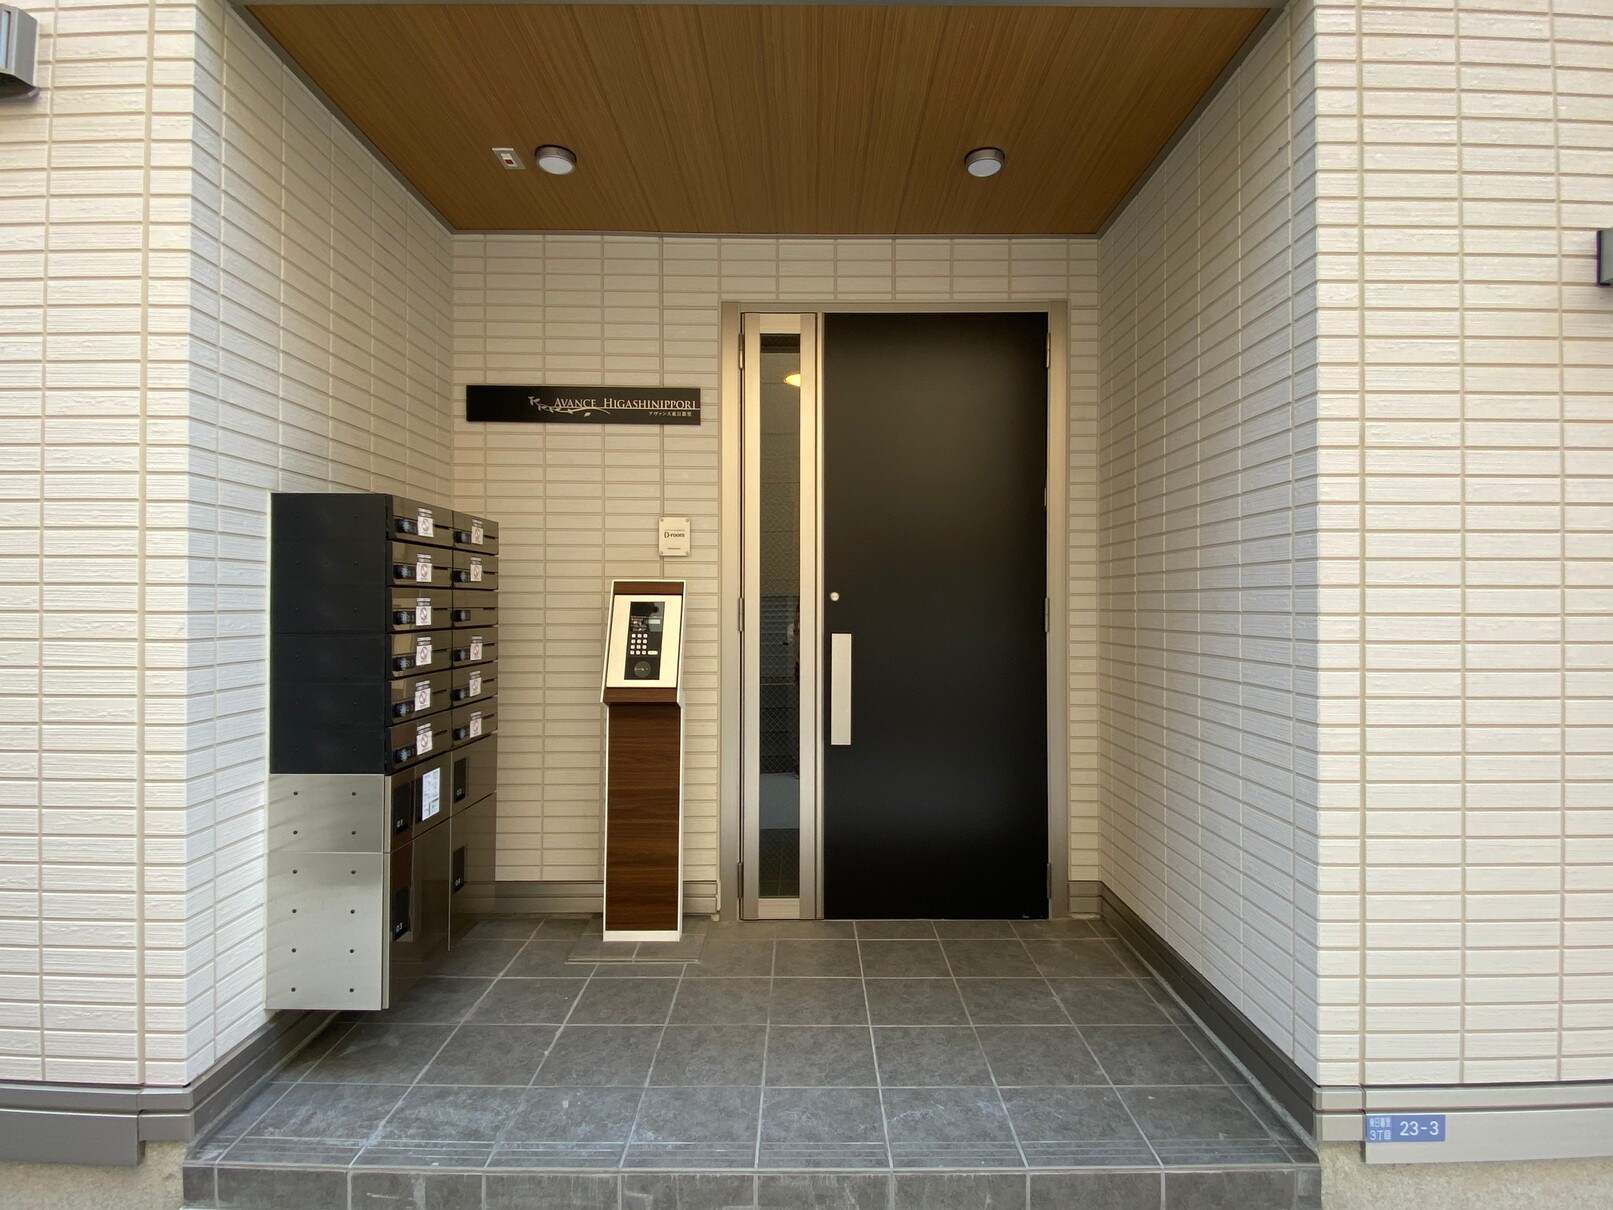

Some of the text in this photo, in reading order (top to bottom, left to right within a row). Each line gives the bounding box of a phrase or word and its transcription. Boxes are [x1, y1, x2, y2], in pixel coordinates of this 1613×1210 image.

[554, 397, 696, 410] AVANCE HIGASHINIPPORI
[1399, 1120, 1439, 1136] 23-3
[1369, 1130, 1392, 1141] 3丁目
